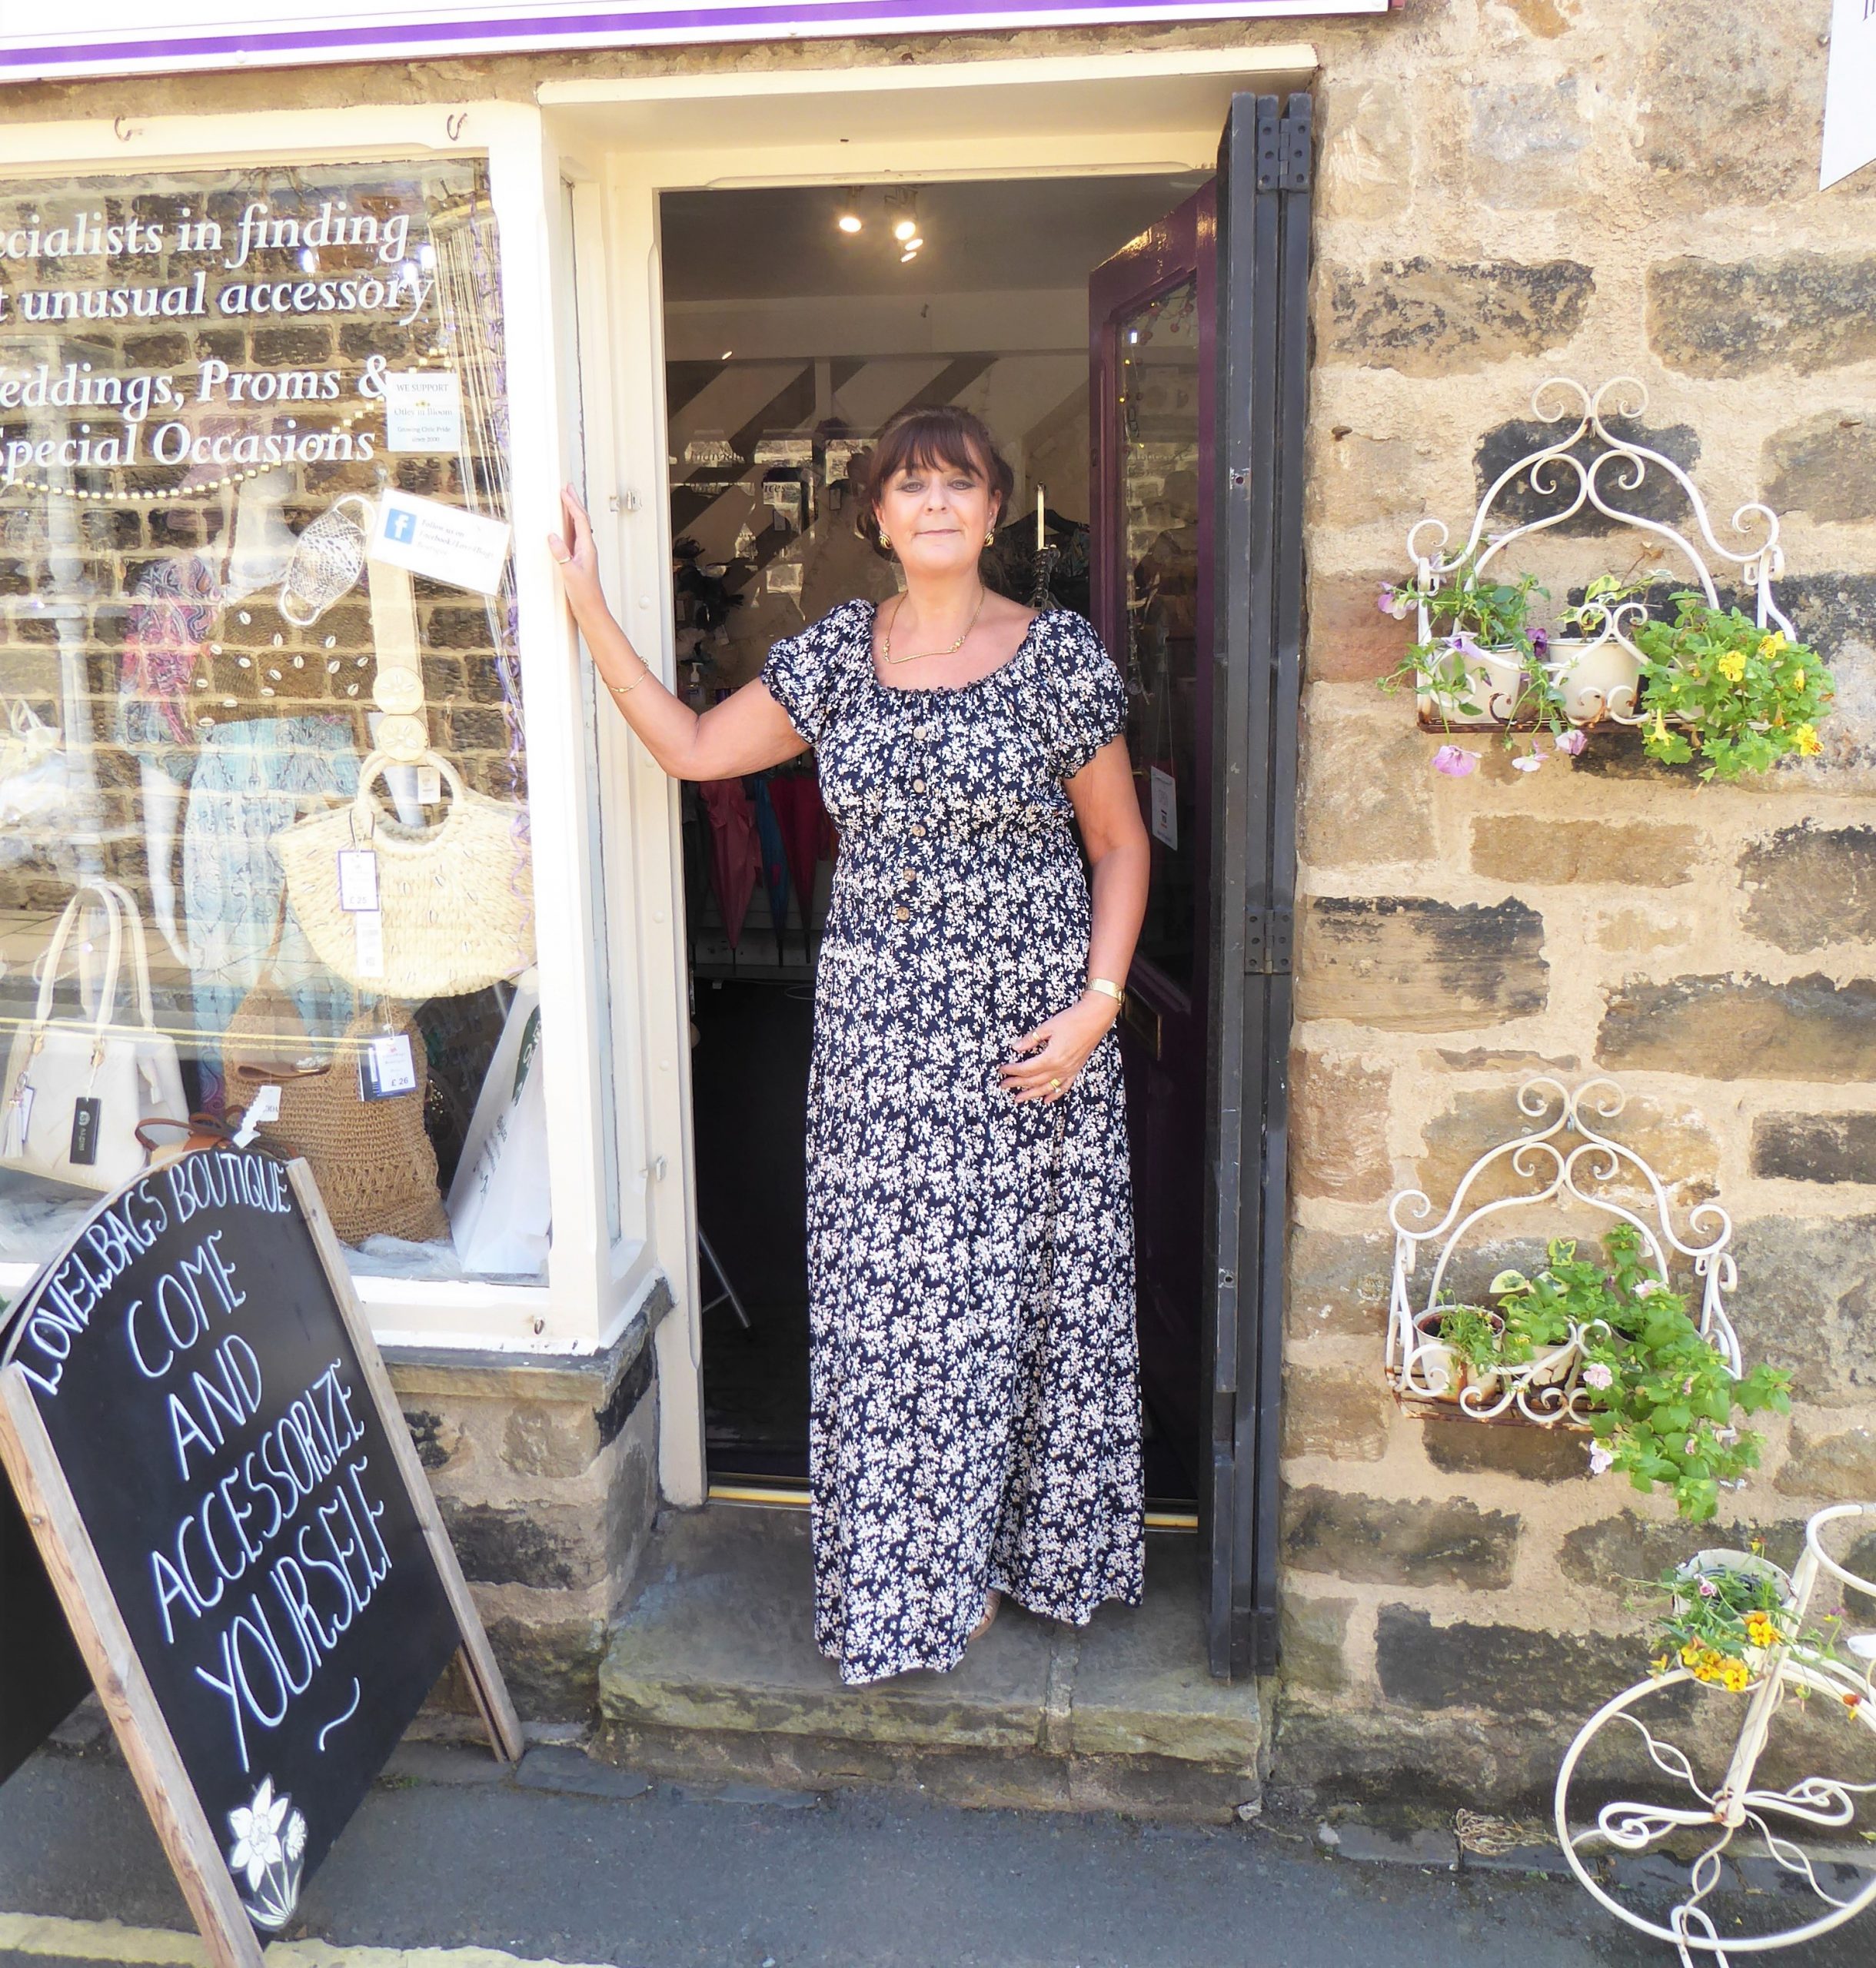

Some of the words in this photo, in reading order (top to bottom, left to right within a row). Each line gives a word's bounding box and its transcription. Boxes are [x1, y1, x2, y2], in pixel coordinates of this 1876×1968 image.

[0, 212, 164, 259] cialists
[177, 207, 223, 251] in
[225, 202, 410, 268] finding
[22, 271, 207, 320] unusual
[220, 278, 435, 327] accessory
[0, 362, 185, 422] eddings,
[197, 359, 341, 401] Proms
[358, 354, 389, 399] &
[397, 384, 410, 392] WE
[411, 384, 449, 392] SUPPORT
[0, 423, 137, 486] pecial
[153, 423, 375, 465] Occasions
[168, 1152, 291, 1223] BOUTIQUE
[127, 1229, 247, 1378] COME
[168, 1335, 262, 1481] AND
[151, 1358, 365, 1644] ACCESSORIZE
[195, 1455, 393, 1773] YOURSELF
